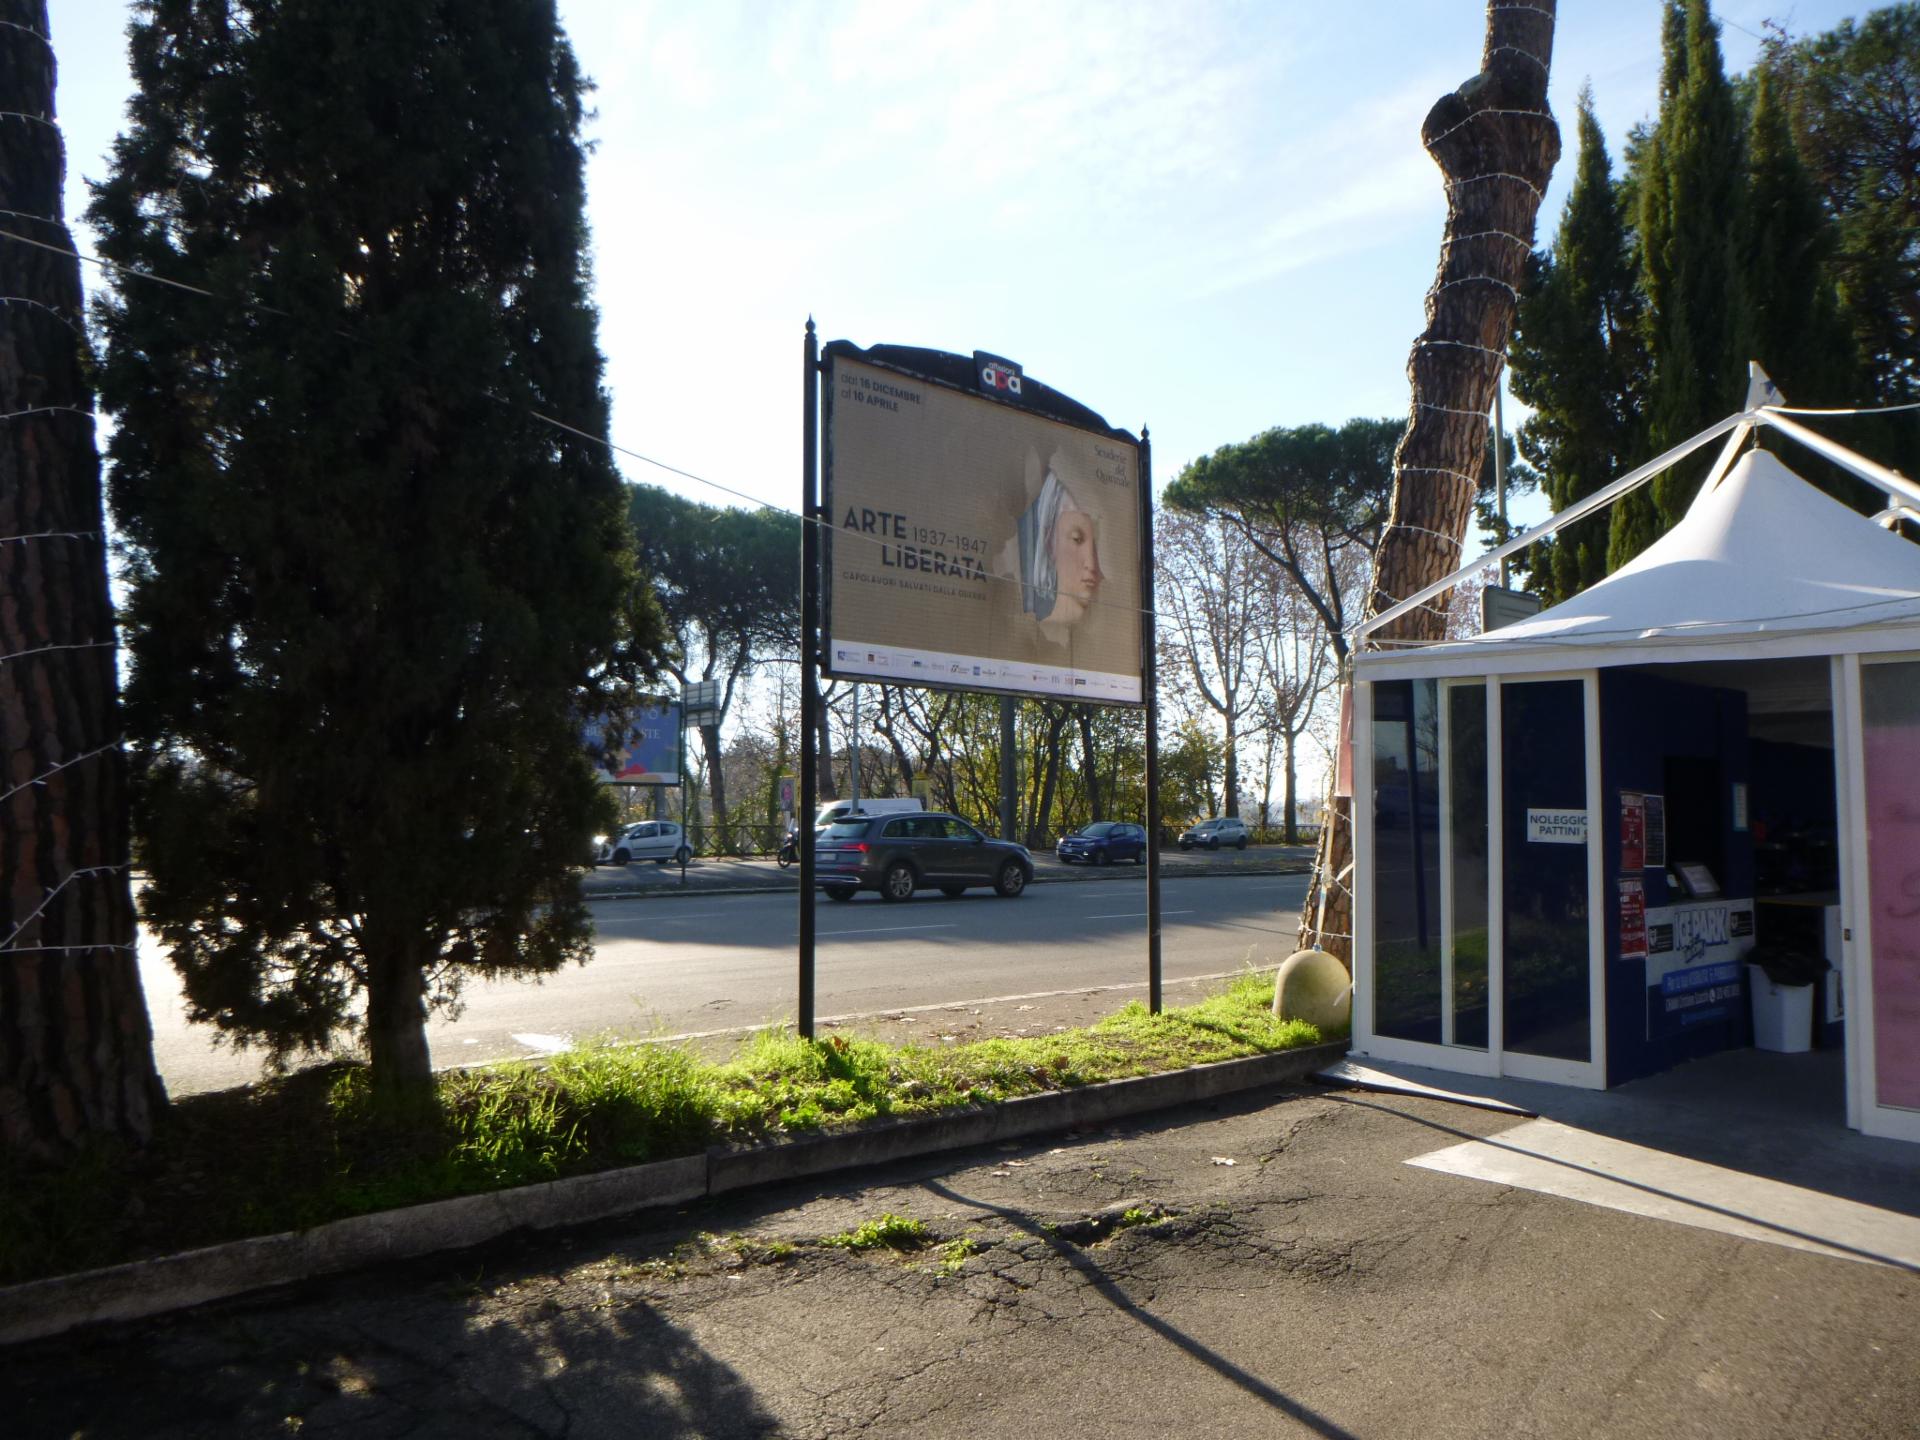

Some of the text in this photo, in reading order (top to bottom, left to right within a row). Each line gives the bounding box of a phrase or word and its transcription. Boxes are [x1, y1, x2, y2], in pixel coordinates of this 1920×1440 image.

[853, 390, 864, 402] 10
[866, 394, 899, 413] APRILE
[872, 381, 921, 405] DICEMBRE
[843, 506, 988, 554] ARTE 1937-1947
[881, 544, 988, 583] LIBERATA
[1530, 815, 1588, 825] NOLEGGIO
[1539, 826, 1580, 836] PATTINI
